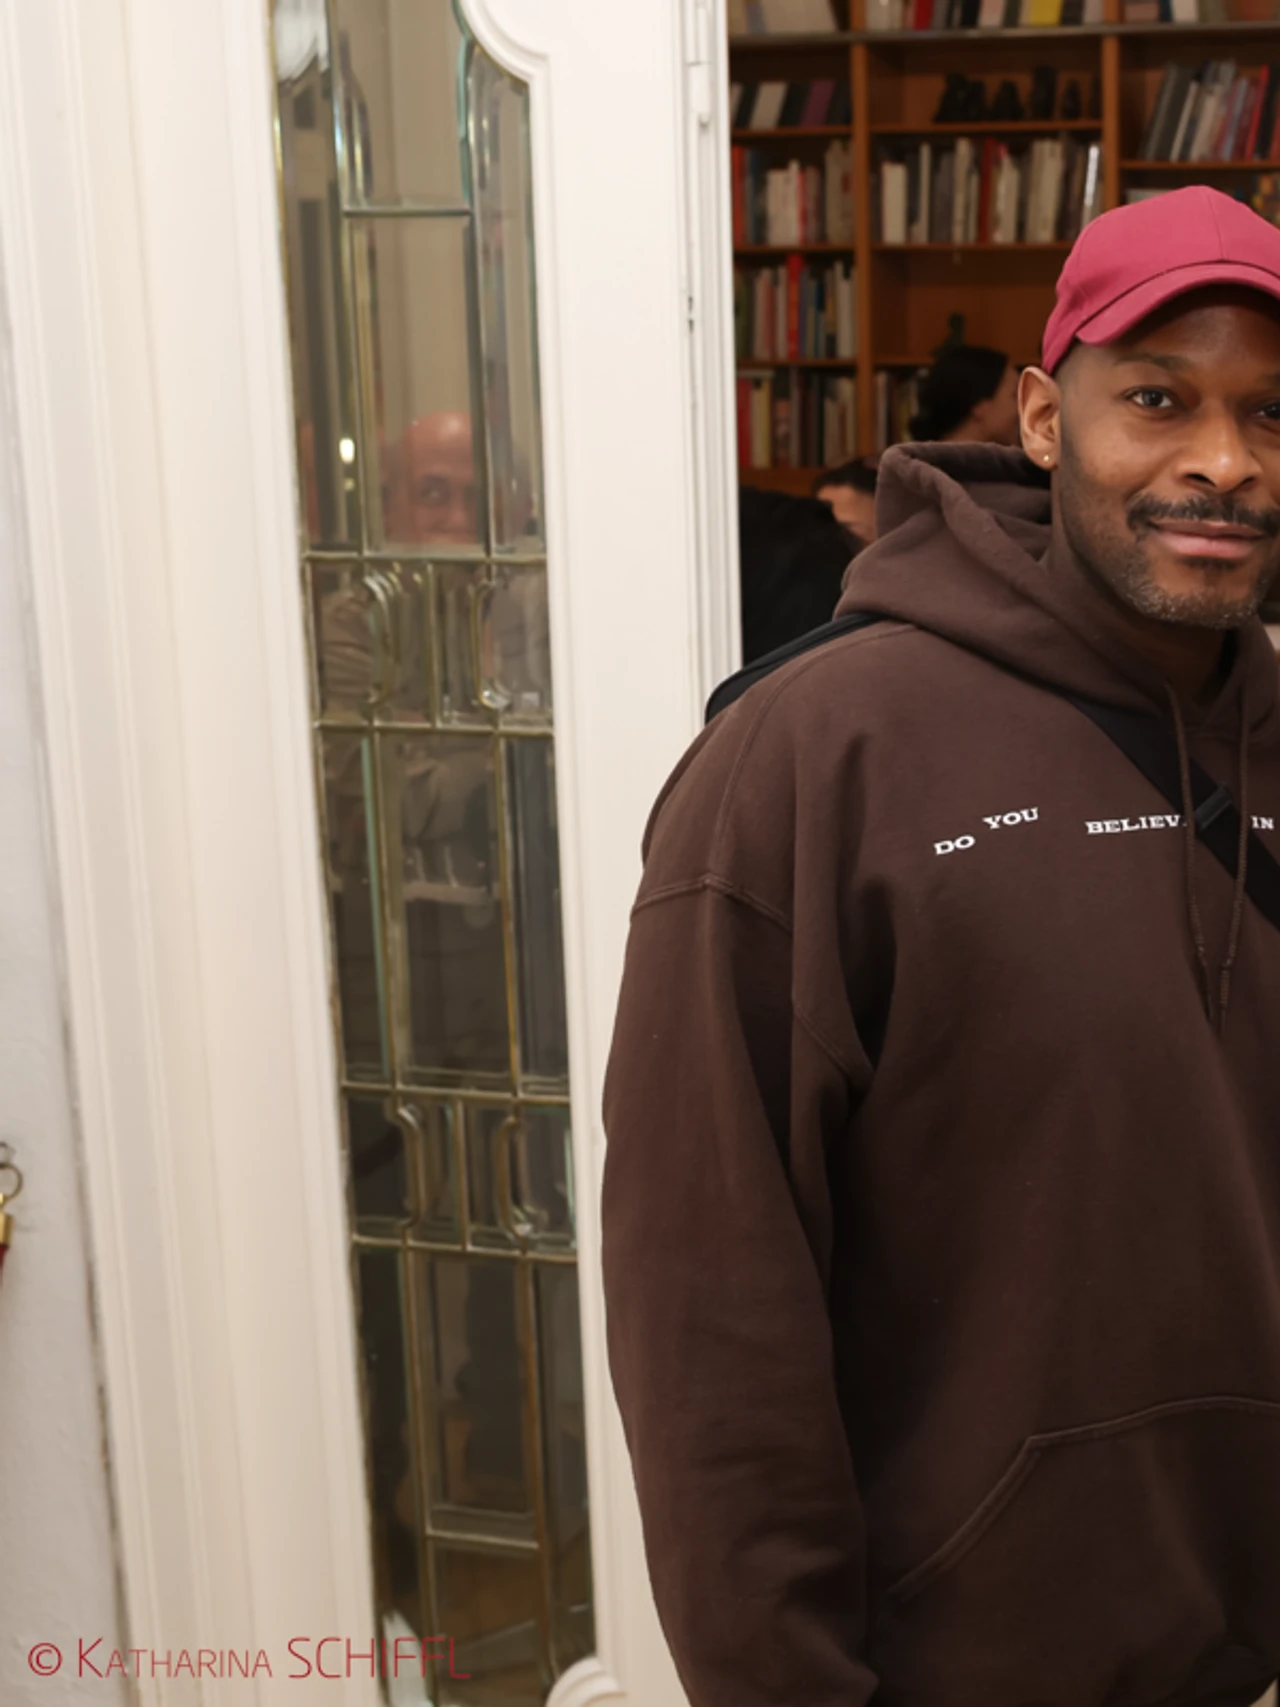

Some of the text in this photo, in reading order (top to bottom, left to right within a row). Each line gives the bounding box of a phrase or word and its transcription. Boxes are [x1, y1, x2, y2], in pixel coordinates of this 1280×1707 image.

[933, 835, 976, 855] DO
[982, 806, 1039, 830] YOU
[1085, 814, 1188, 834] BELIEV
[1250, 815, 1275, 830] IN
